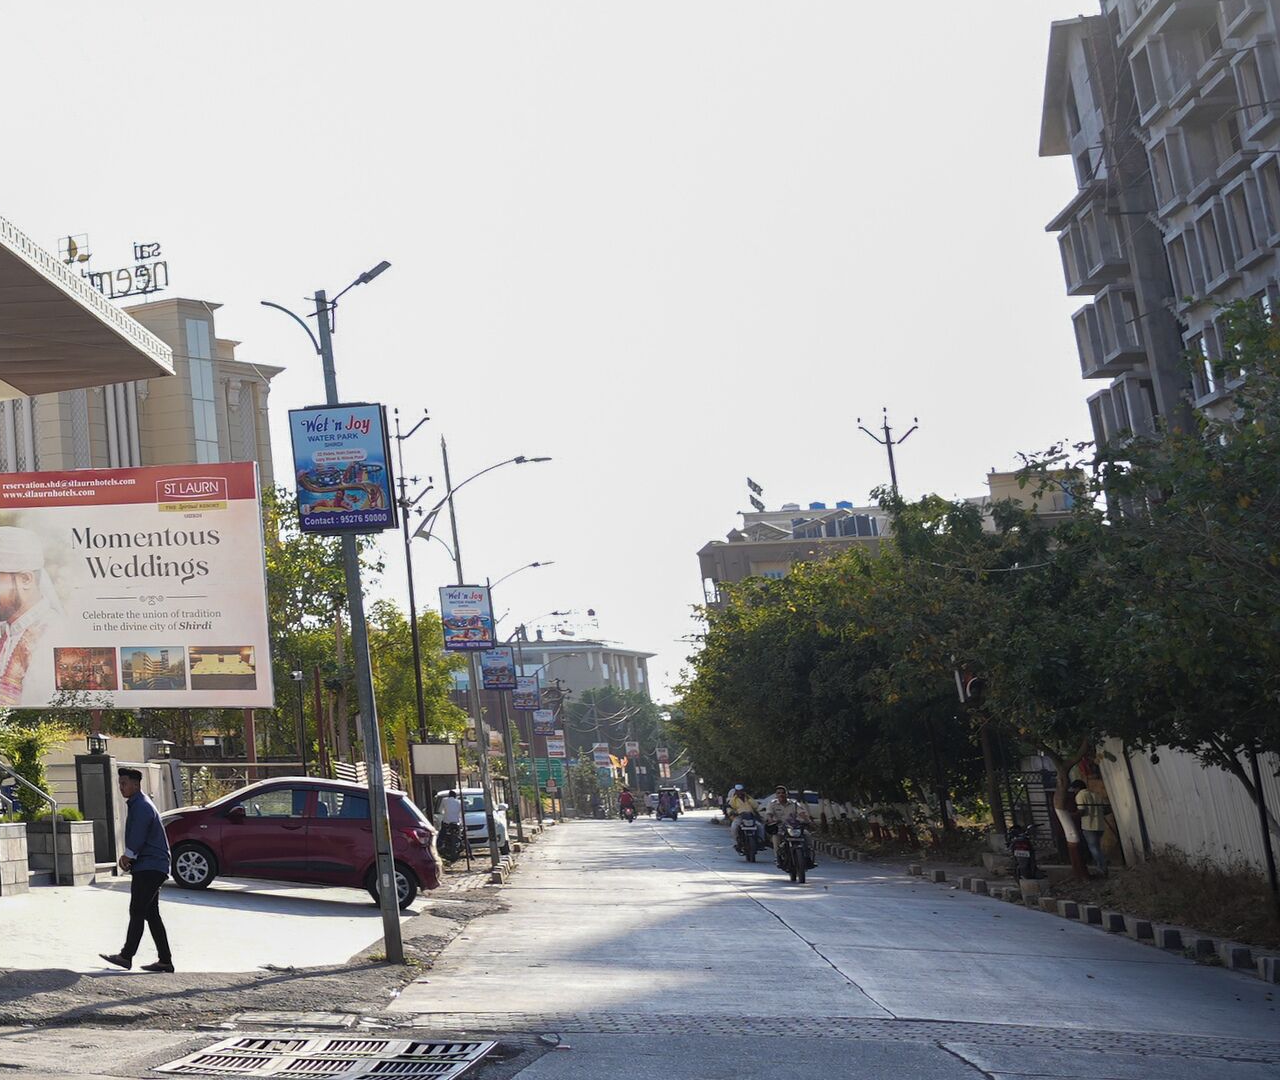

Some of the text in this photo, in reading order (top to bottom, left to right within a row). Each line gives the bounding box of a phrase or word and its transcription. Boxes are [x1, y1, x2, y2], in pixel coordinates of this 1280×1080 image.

[301, 414, 328, 432] Wet
[345, 415, 371, 434] Joy
[307, 434, 334, 442] WATER
[2, 478, 136, 490] reservation.shd@stlaurnhotels.com
[164, 481, 219, 494] ST LAURN
[2, 489, 96, 499] www.stlaurnhotels.com
[305, 517, 334, 525] Contact
[340, 515, 363, 523] 95276
[365, 514, 387, 522] 50000
[71, 527, 220, 550] Momentous
[86, 554, 209, 585] Weddings
[82, 609, 222, 620] Celebrate the union of tradition
[93, 621, 212, 632] in the divine city of Shirdi
